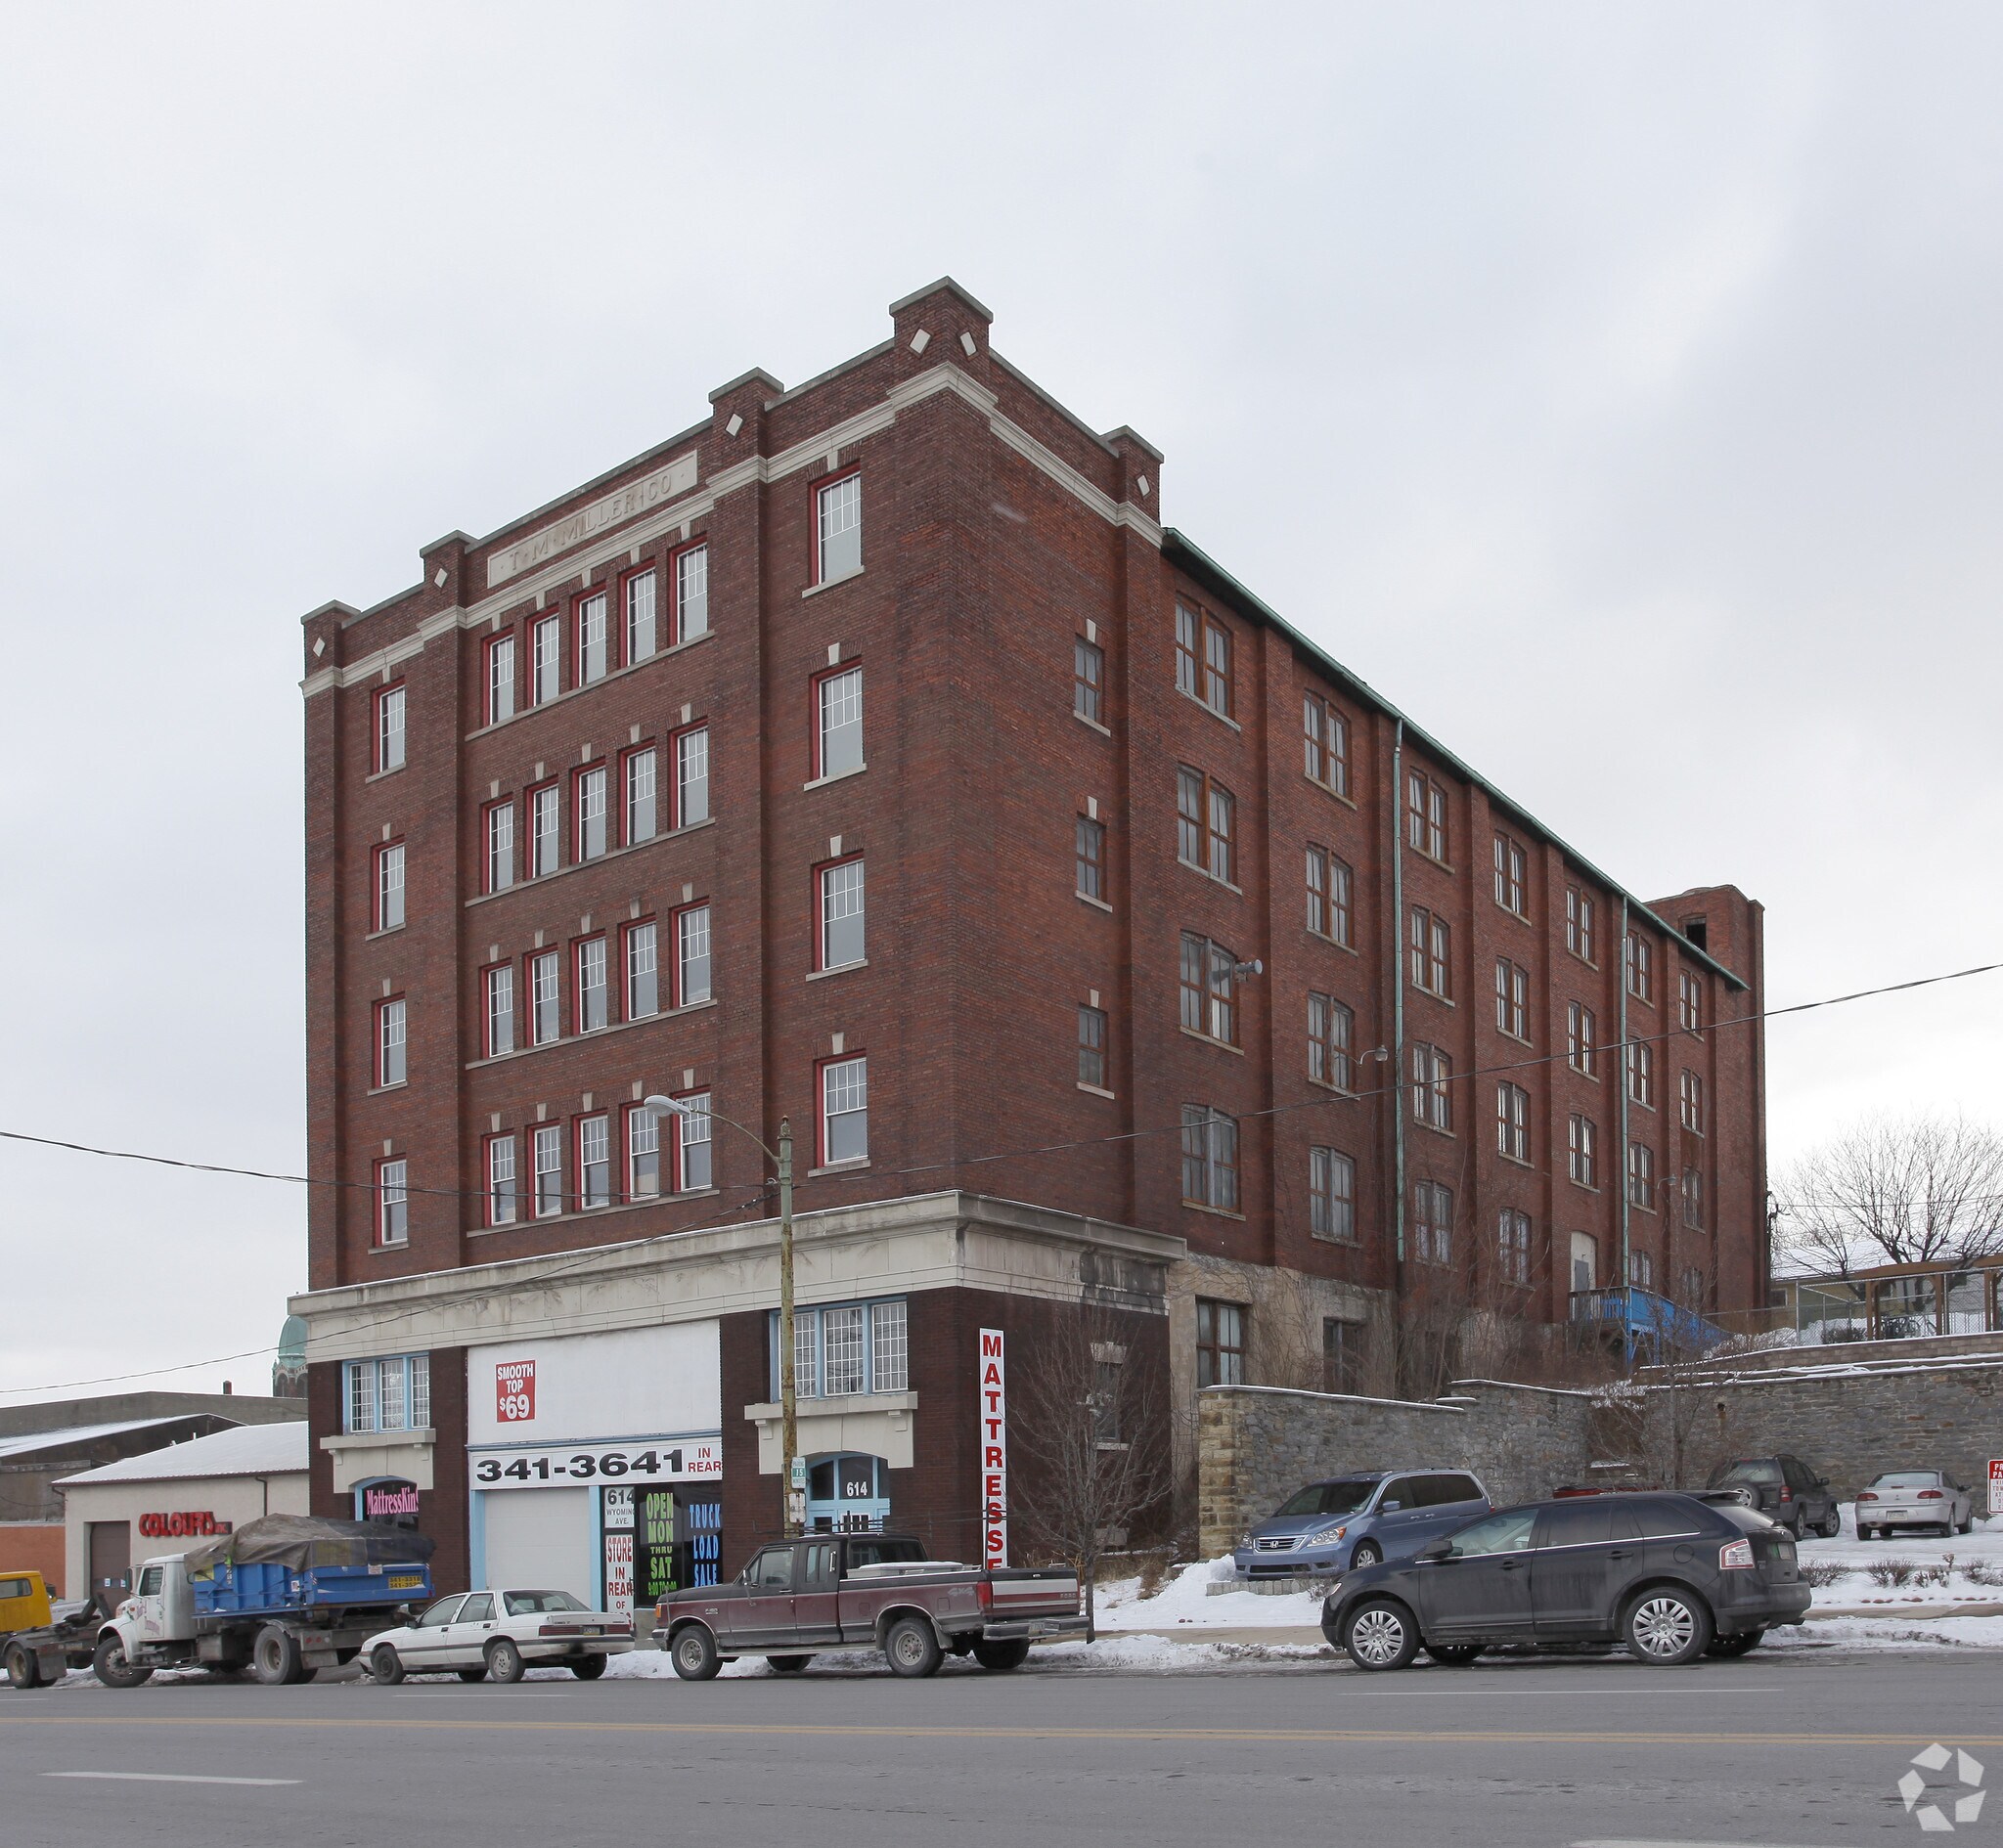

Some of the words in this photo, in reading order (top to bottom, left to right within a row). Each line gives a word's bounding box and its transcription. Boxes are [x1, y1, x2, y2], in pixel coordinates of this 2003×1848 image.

[497, 1363, 534, 1381] SMOOTH
[506, 1379, 524, 1394] TOP
[499, 1393, 530, 1420] $69
[698, 1447, 711, 1459] IN
[476, 1449, 683, 1482] 341-3641
[688, 1461, 722, 1474] REAR
[795, 1468, 804, 1476] 15
[607, 1488, 634, 1506] 614
[846, 1480, 868, 1497] 614
[645, 1492, 674, 1520] OPEN
[138, 1511, 214, 1538] COLOURS
[615, 1517, 629, 1525] AVE.
[689, 1503, 721, 1528] TRUCK
[647, 1520, 674, 1544] MON
[607, 1536, 632, 1563] STORE
[650, 1546, 673, 1555] THRU
[692, 1534, 719, 1560] LOAD
[615, 1566, 625, 1579] IN
[650, 1556, 672, 1579] SAT
[694, 1563, 718, 1588] SALE
[608, 1581, 634, 1597] REAR
[615, 1601, 626, 1609] OF
